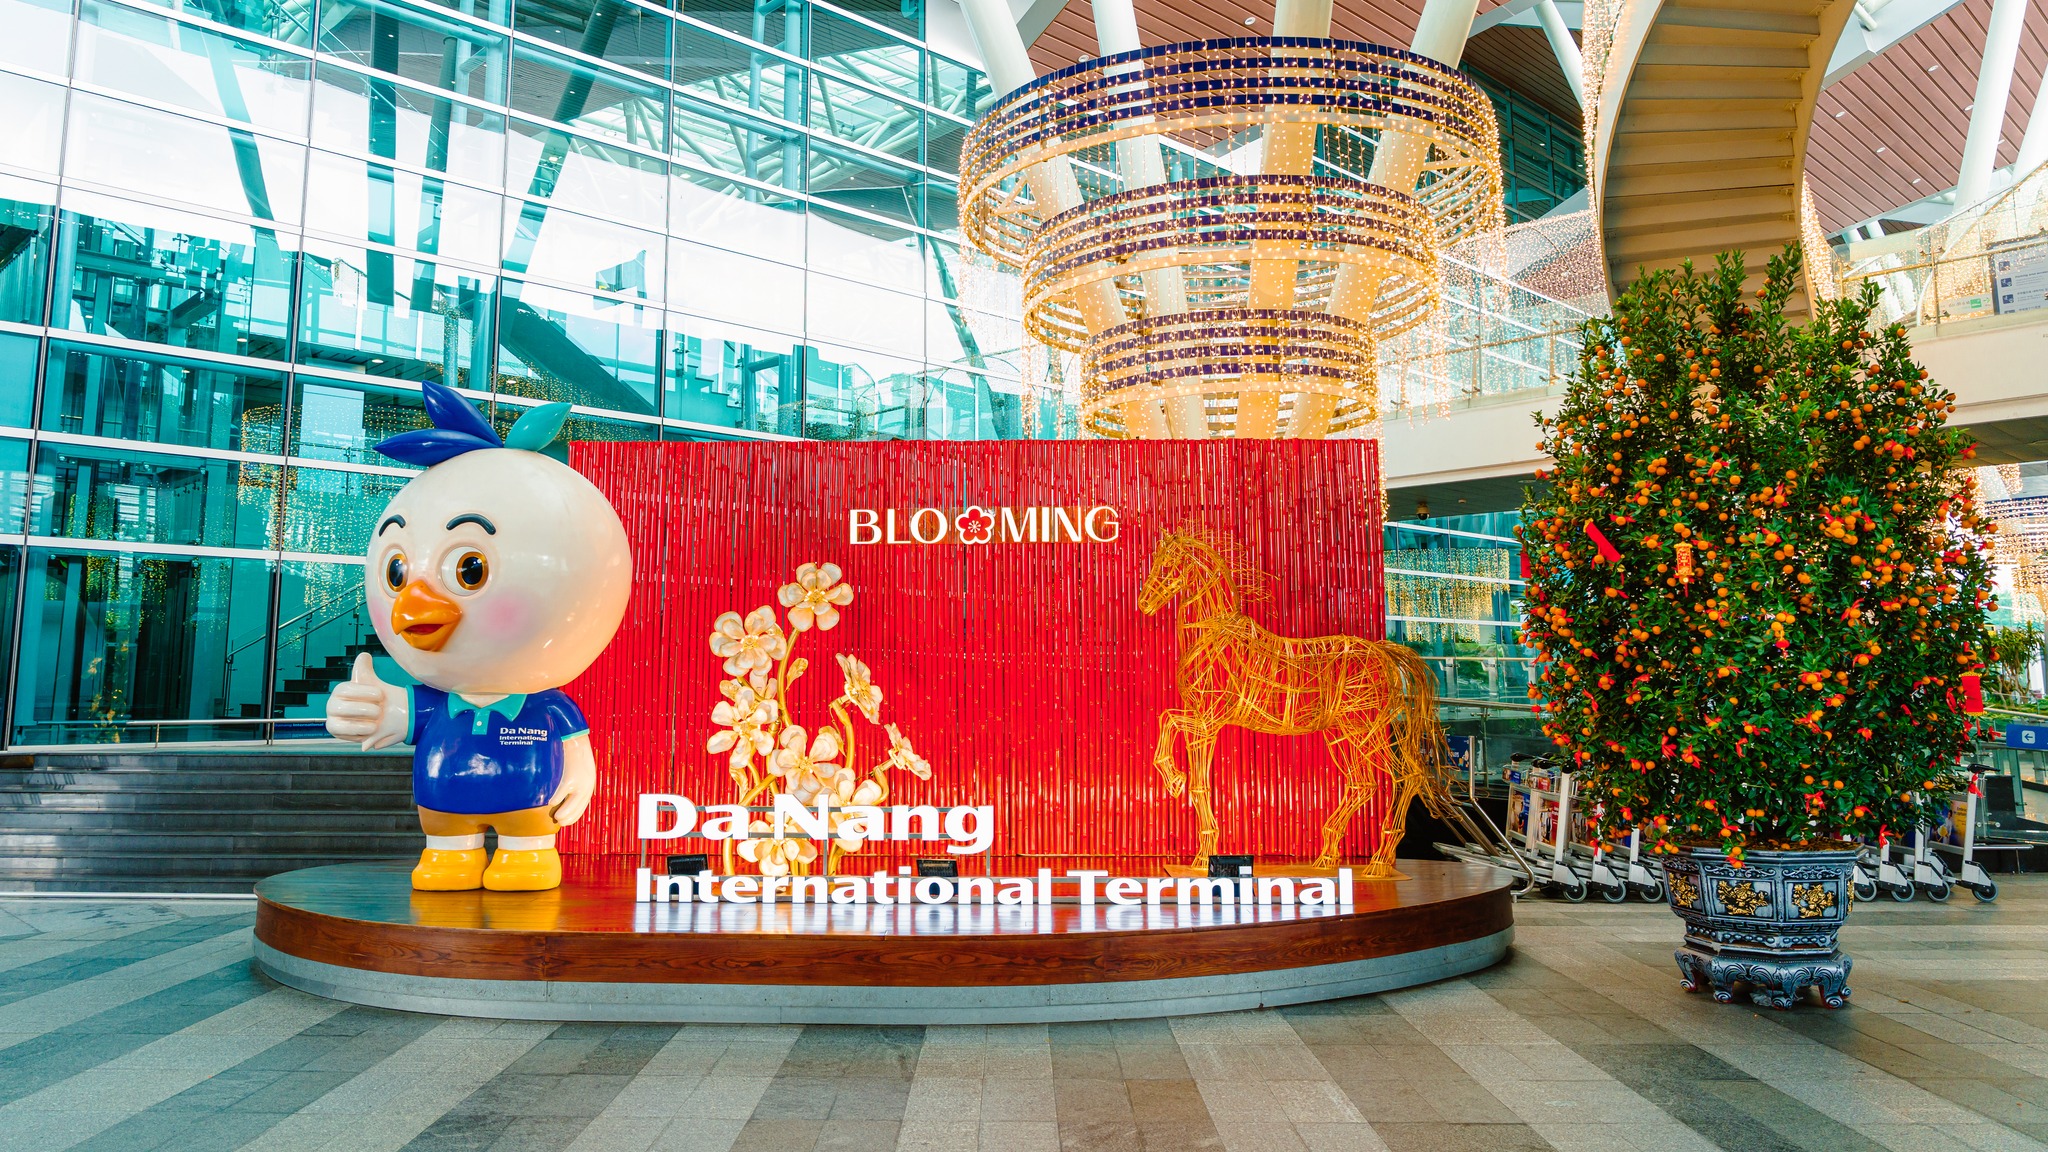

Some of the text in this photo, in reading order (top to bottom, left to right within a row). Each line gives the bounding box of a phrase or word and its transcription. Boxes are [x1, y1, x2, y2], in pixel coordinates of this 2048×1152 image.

[518, 727, 548, 737] Nang
[638, 793, 995, 855] Da Nang
[636, 866, 1354, 906] International Terminal
